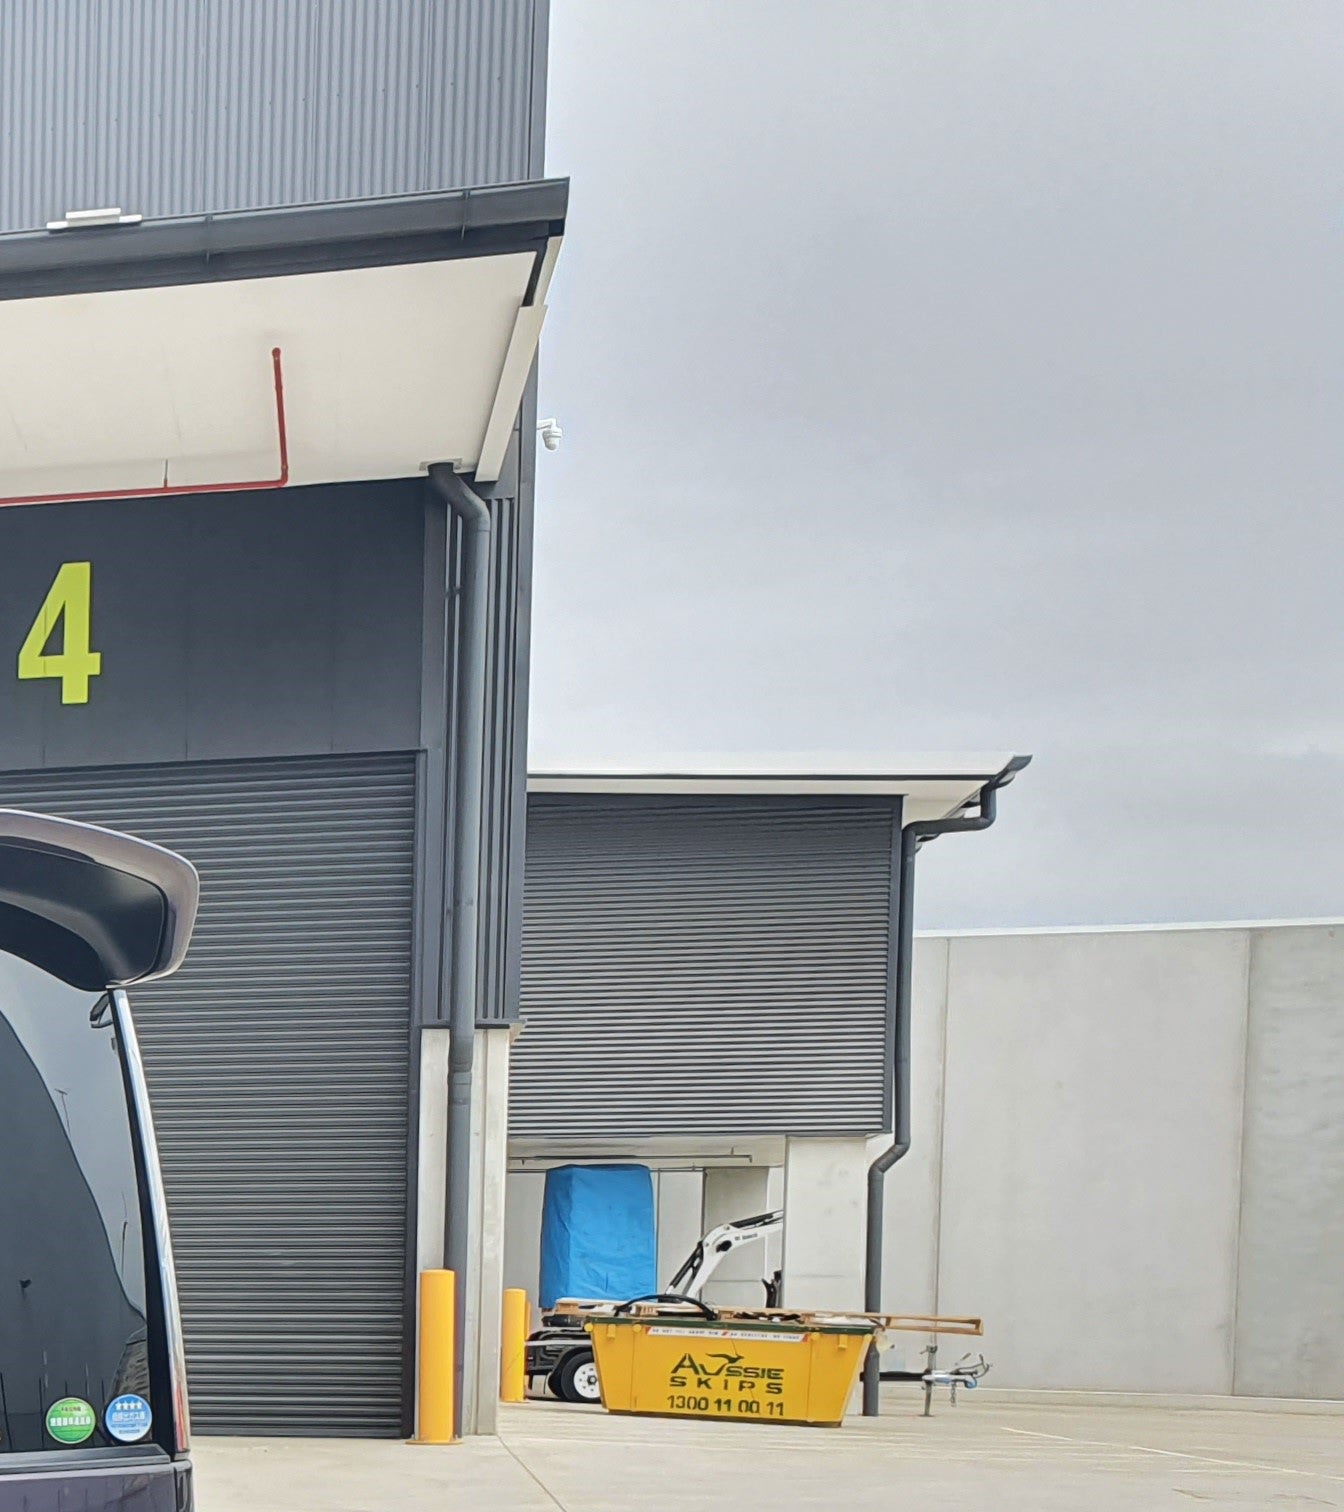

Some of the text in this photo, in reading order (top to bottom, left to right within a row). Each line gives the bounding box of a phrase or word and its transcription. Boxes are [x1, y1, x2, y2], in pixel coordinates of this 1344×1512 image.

[18, 561, 101, 704] 4
[669, 1376, 783, 1395] SKIPS
[667, 1395, 785, 1416] 1300 11 00 11
